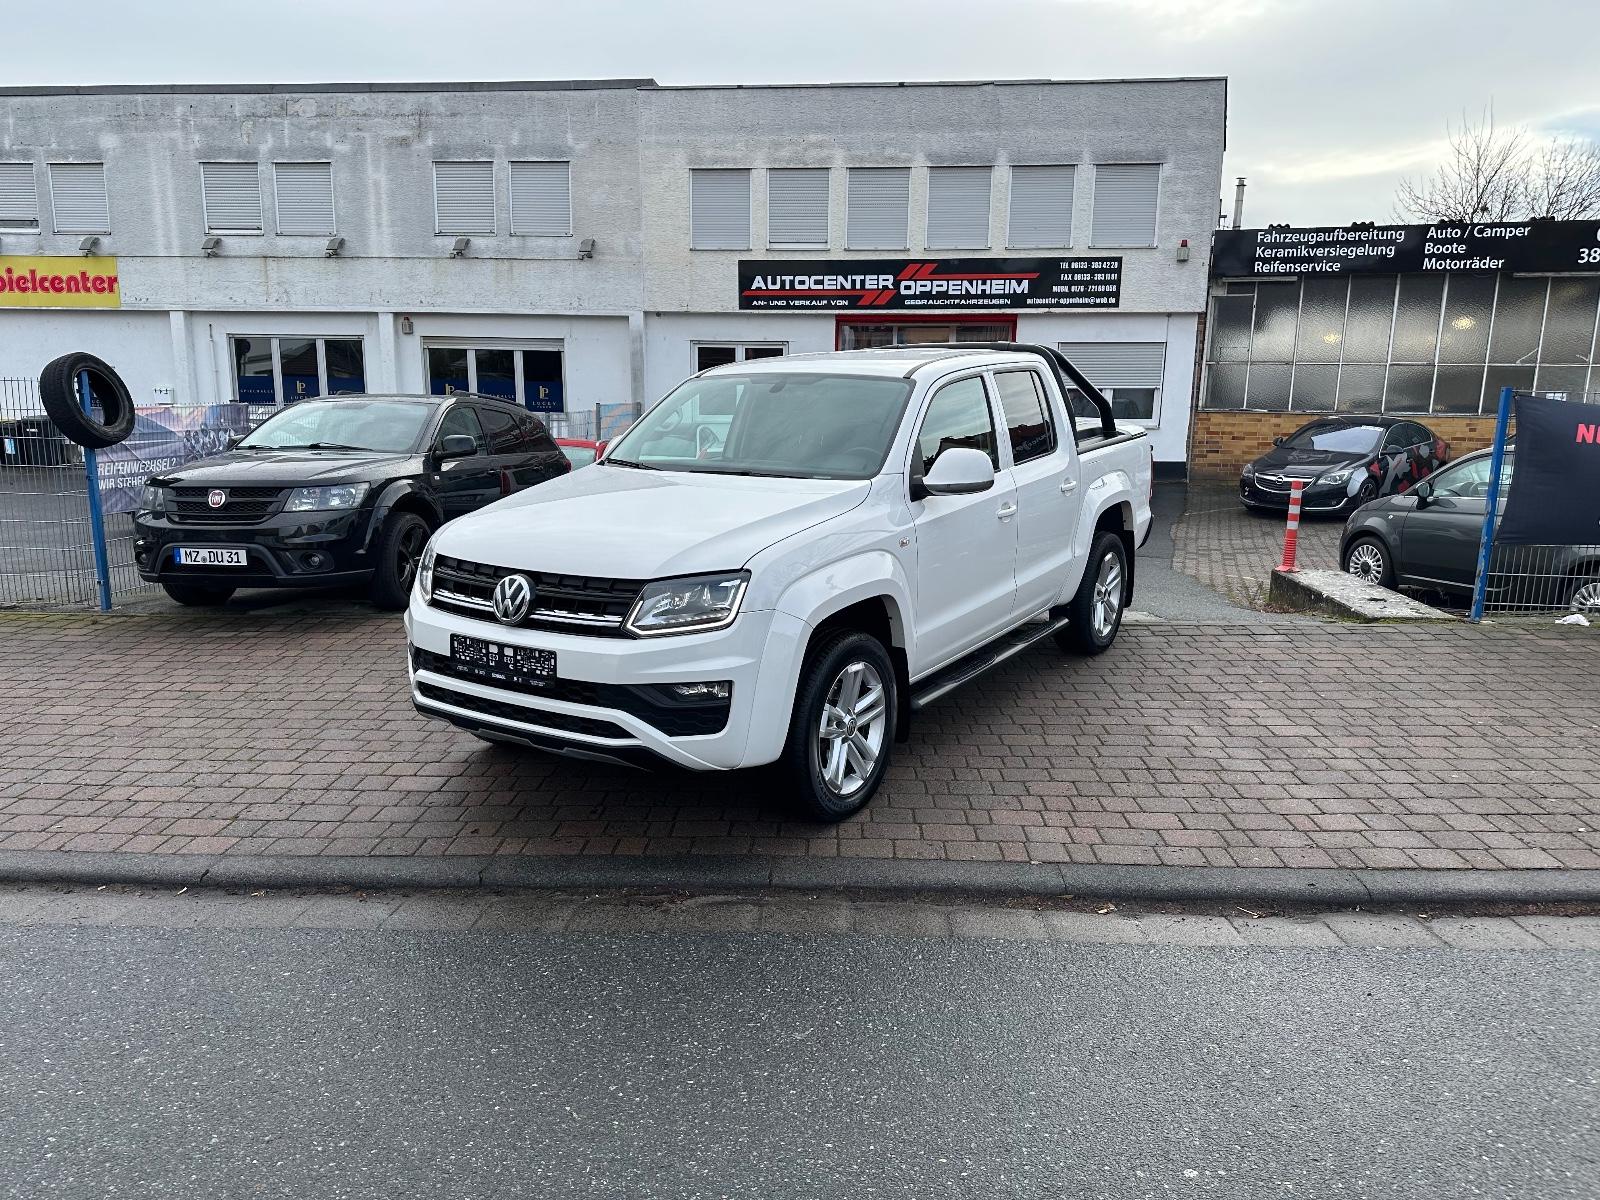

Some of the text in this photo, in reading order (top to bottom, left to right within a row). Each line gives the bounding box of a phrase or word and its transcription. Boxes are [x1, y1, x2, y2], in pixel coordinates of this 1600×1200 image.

[1257, 229, 1405, 244] Fahrzeugaufbereitung
[1427, 227, 1461, 239] Auto
[1474, 225, 1531, 240] Camper
[1255, 244, 1396, 259] Keramikversiegelung
[1424, 242, 1466, 254] Boote
[1254, 260, 1341, 273] Reifenservice
[1422, 256, 1505, 270] Motorräder
[750, 274, 895, 290] AUTOCENTER
[900, 279, 1029, 295] OPPENHEIM
[1576, 423, 1600, 444] N
[99, 478, 115, 490] WIR
[184, 550, 200, 562] MZ
[208, 550, 224, 563] DU
[226, 551, 242, 563] 31
